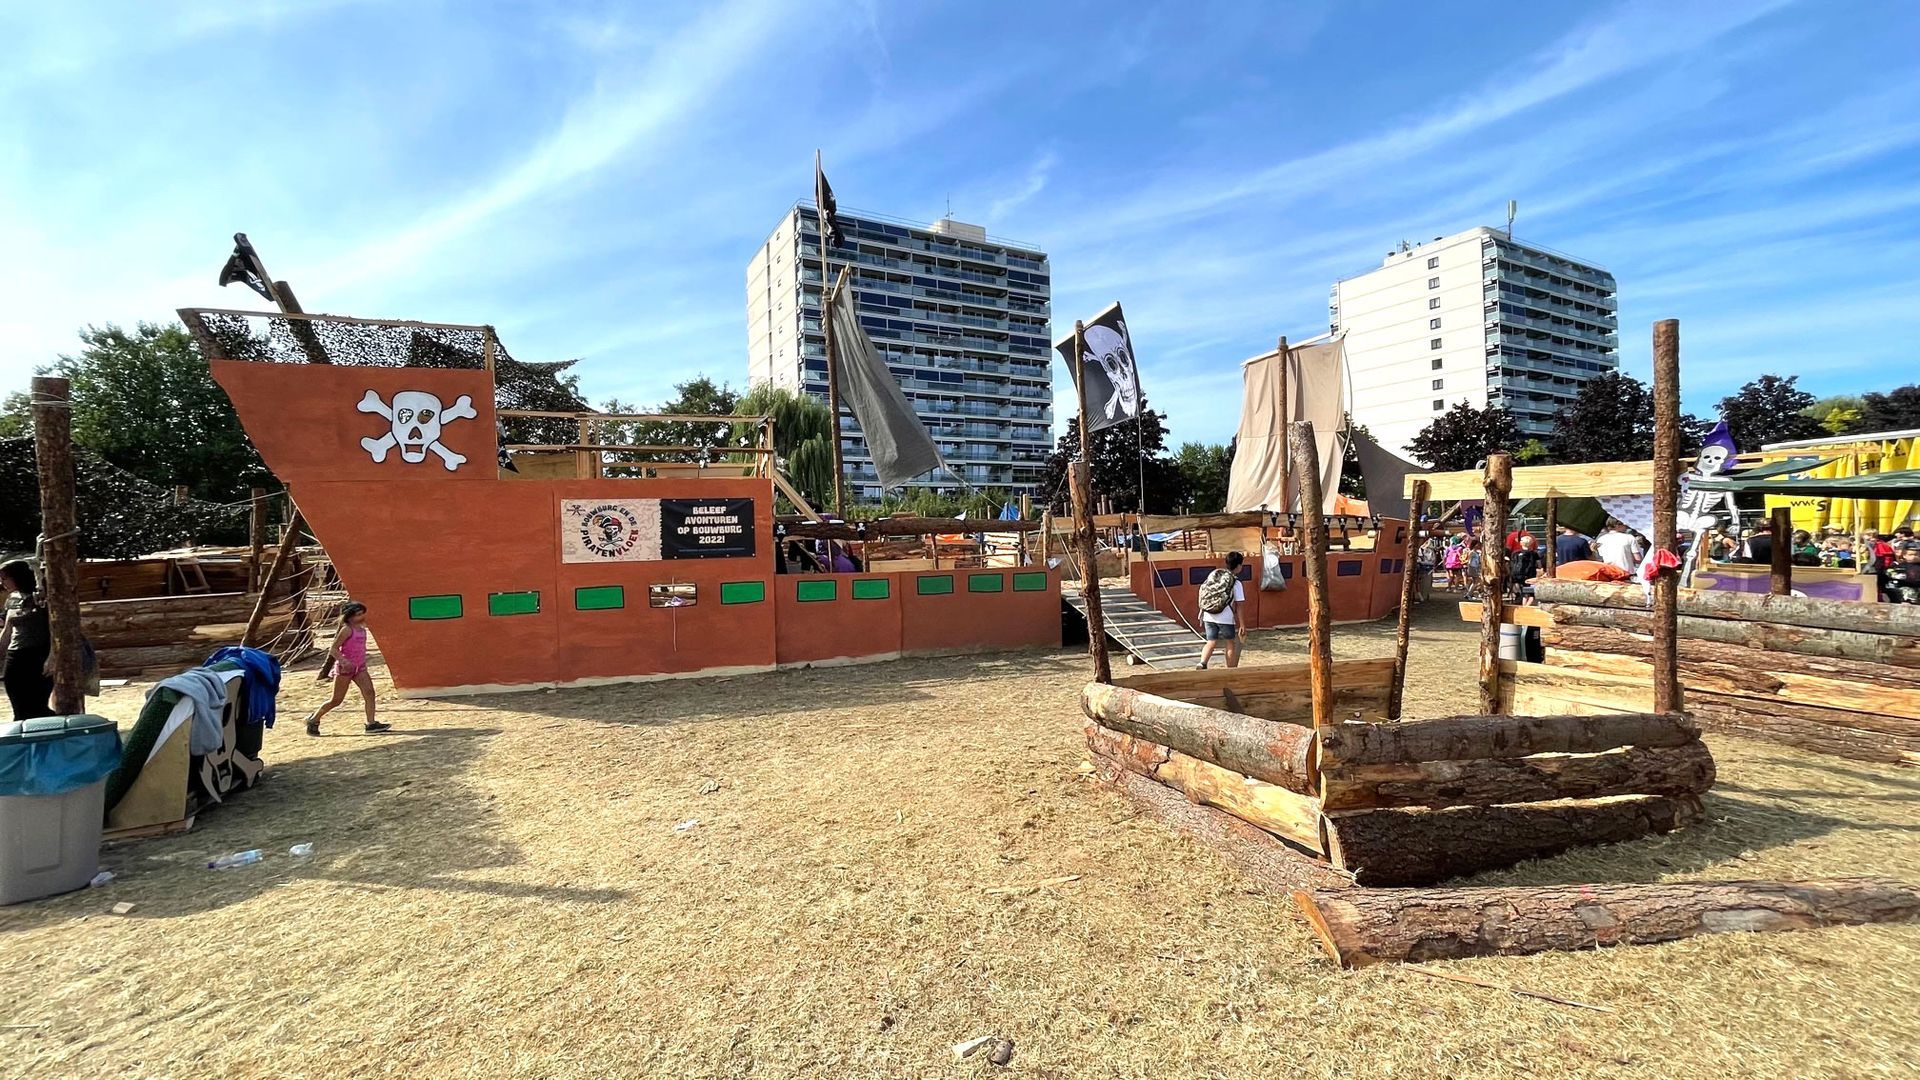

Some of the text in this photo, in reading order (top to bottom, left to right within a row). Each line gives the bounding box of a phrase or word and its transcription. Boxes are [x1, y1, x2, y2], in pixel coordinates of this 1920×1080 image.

[692, 506, 727, 515] BELEEF
[581, 504, 637, 528] BOUWBURG EN DE
[684, 515, 738, 525] AVONTUREN
[677, 525, 742, 535] OP BOUWBURG
[698, 535, 725, 544] 2022!
